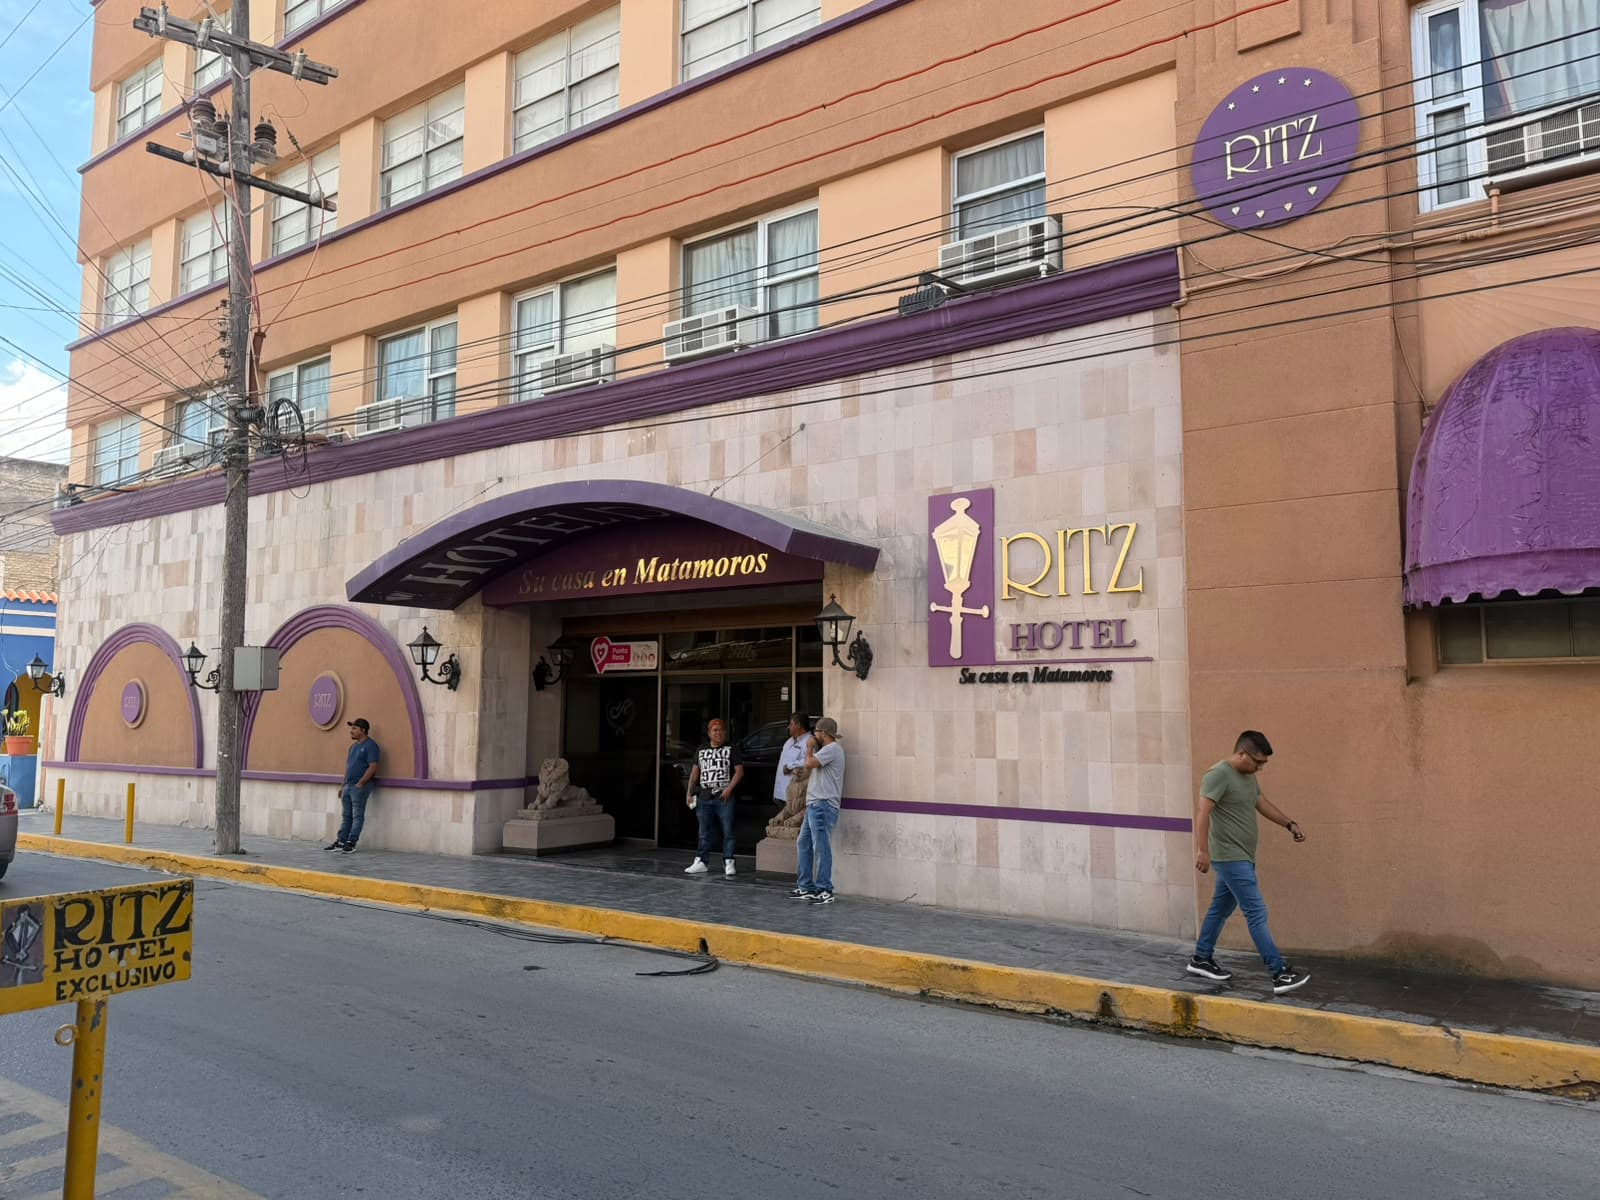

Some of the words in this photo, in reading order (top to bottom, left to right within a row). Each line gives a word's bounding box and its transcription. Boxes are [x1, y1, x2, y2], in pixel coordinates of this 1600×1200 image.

[1225, 114, 1323, 180] RITZ
[519, 568, 545, 594] Su
[551, 570, 596, 592] casa
[601, 566, 628, 588] en
[632, 552, 769, 585] Matamoros
[1000, 522, 1144, 600] RITZ
[1009, 618, 1137, 651] HOTEL
[960, 667, 976, 684] Su
[979, 671, 1009, 683] casa
[1012, 670, 1029, 683] en
[1032, 666, 1113, 683] Matamoros
[53, 884, 192, 950] RITZ
[53, 937, 175, 973] HOTEL
[56, 961, 176, 1001] EXCLUSIVO
